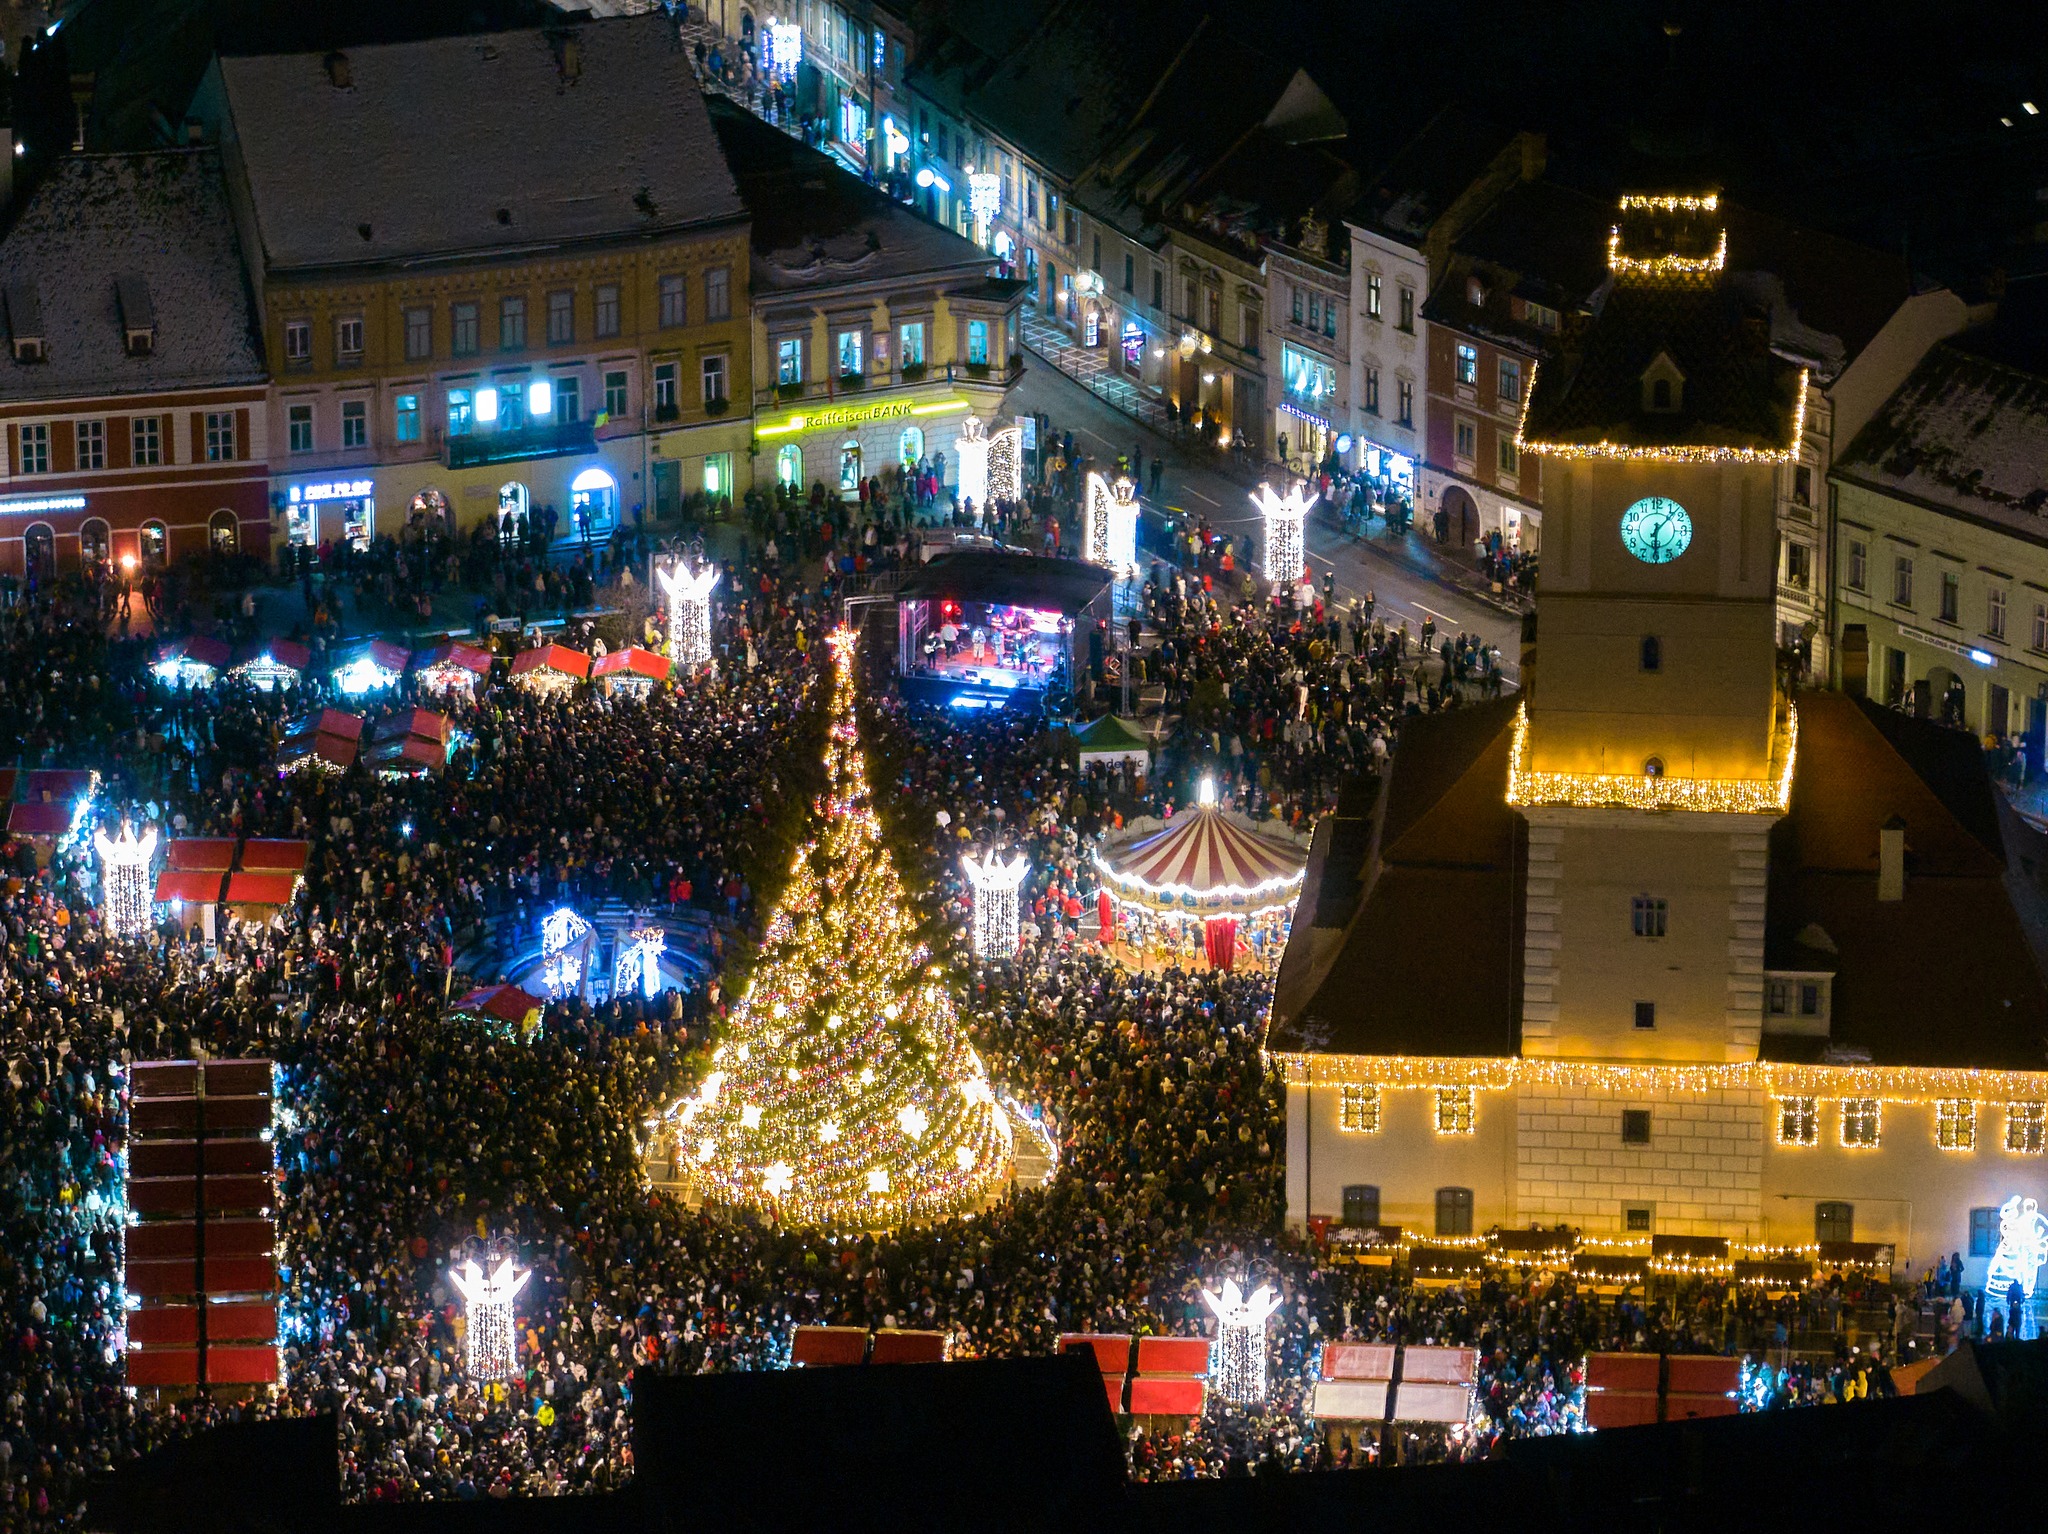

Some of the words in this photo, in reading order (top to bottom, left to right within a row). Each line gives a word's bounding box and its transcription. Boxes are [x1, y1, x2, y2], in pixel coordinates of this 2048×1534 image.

[1640, 503, 1648, 513] 11
[1651, 499, 1663, 510] 12
[1628, 512, 1640, 522] 10
[1677, 512, 1685, 522] 2
[1626, 524, 1633, 535] 9
[1680, 525, 1688, 536] 3
[1629, 537, 1637, 548] 8
[1676, 539, 1683, 549] 4
[1640, 548, 1647, 558] 7
[1665, 548, 1673, 559] 5
